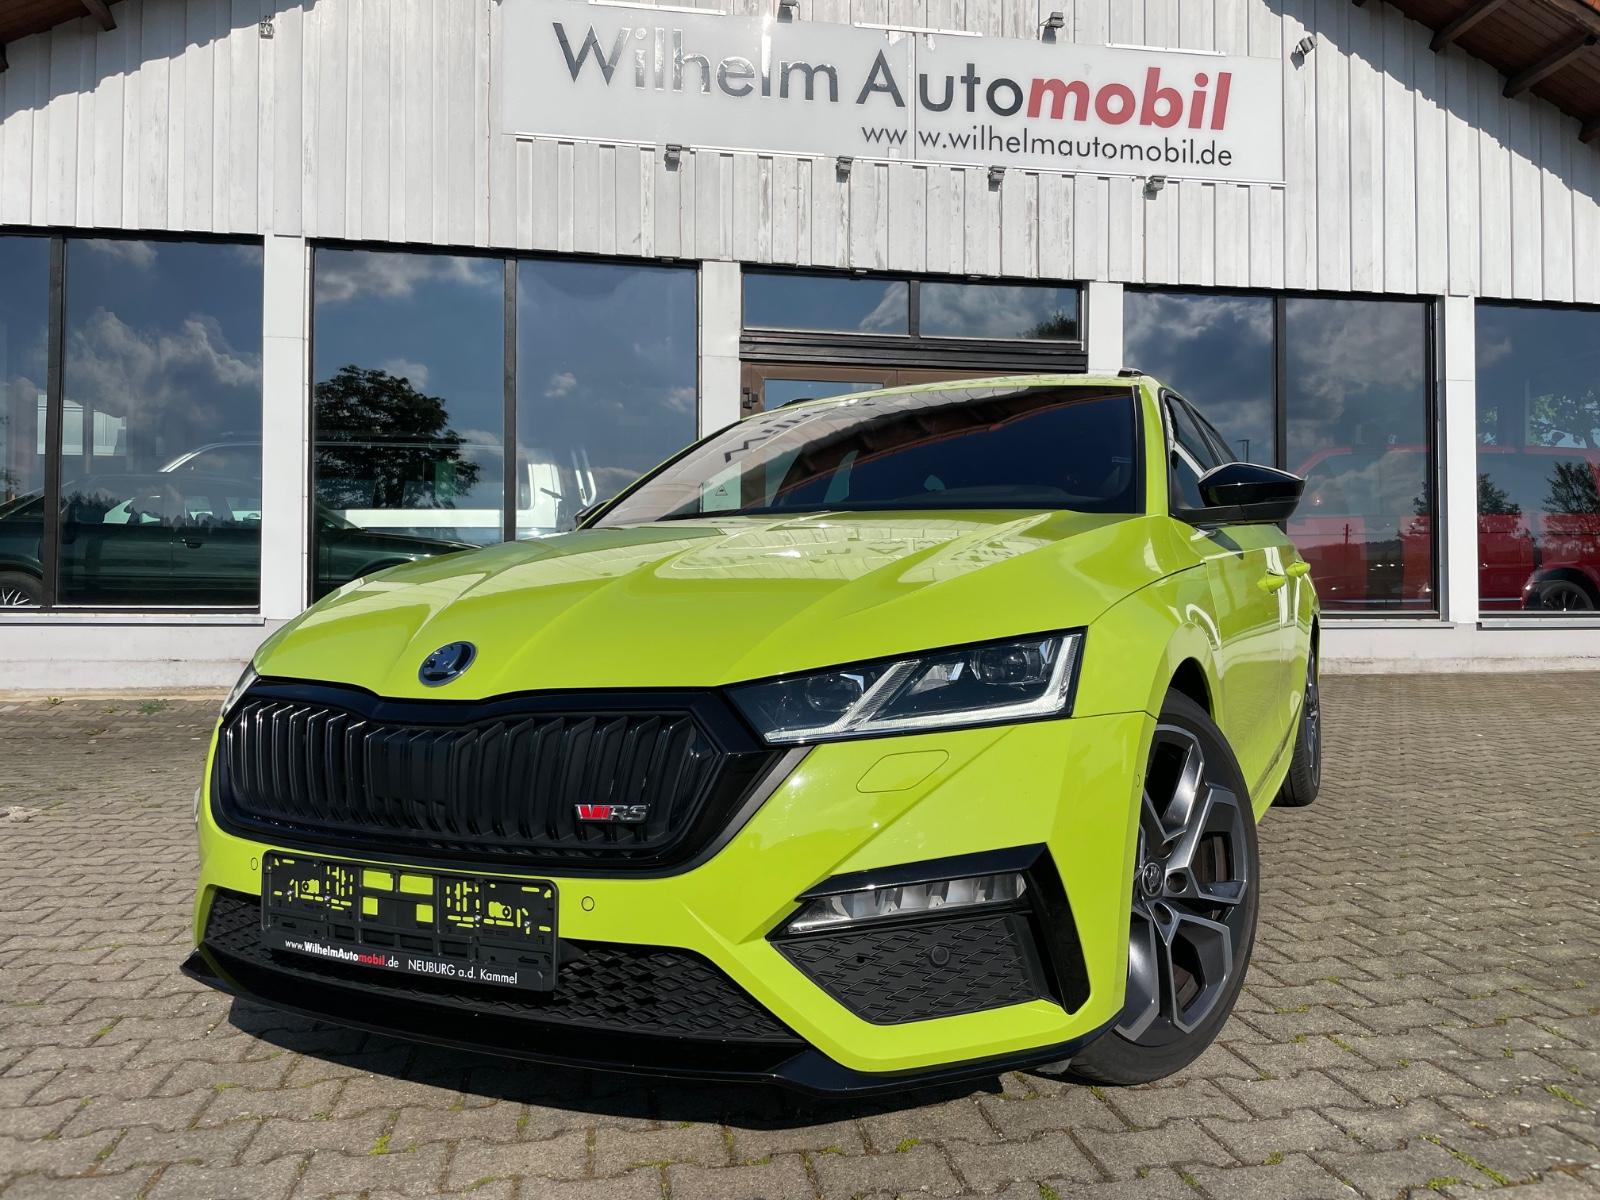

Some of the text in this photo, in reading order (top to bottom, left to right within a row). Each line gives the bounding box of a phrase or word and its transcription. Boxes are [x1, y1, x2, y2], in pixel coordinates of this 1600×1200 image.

[552, 22, 1232, 131] Wilhelm Automobil
[861, 125, 1232, 167] www.wilhelmautomobil.de
[285, 940, 518, 984] www.WilhelmAutomobil.de NEUBURG a.d. Kammel
